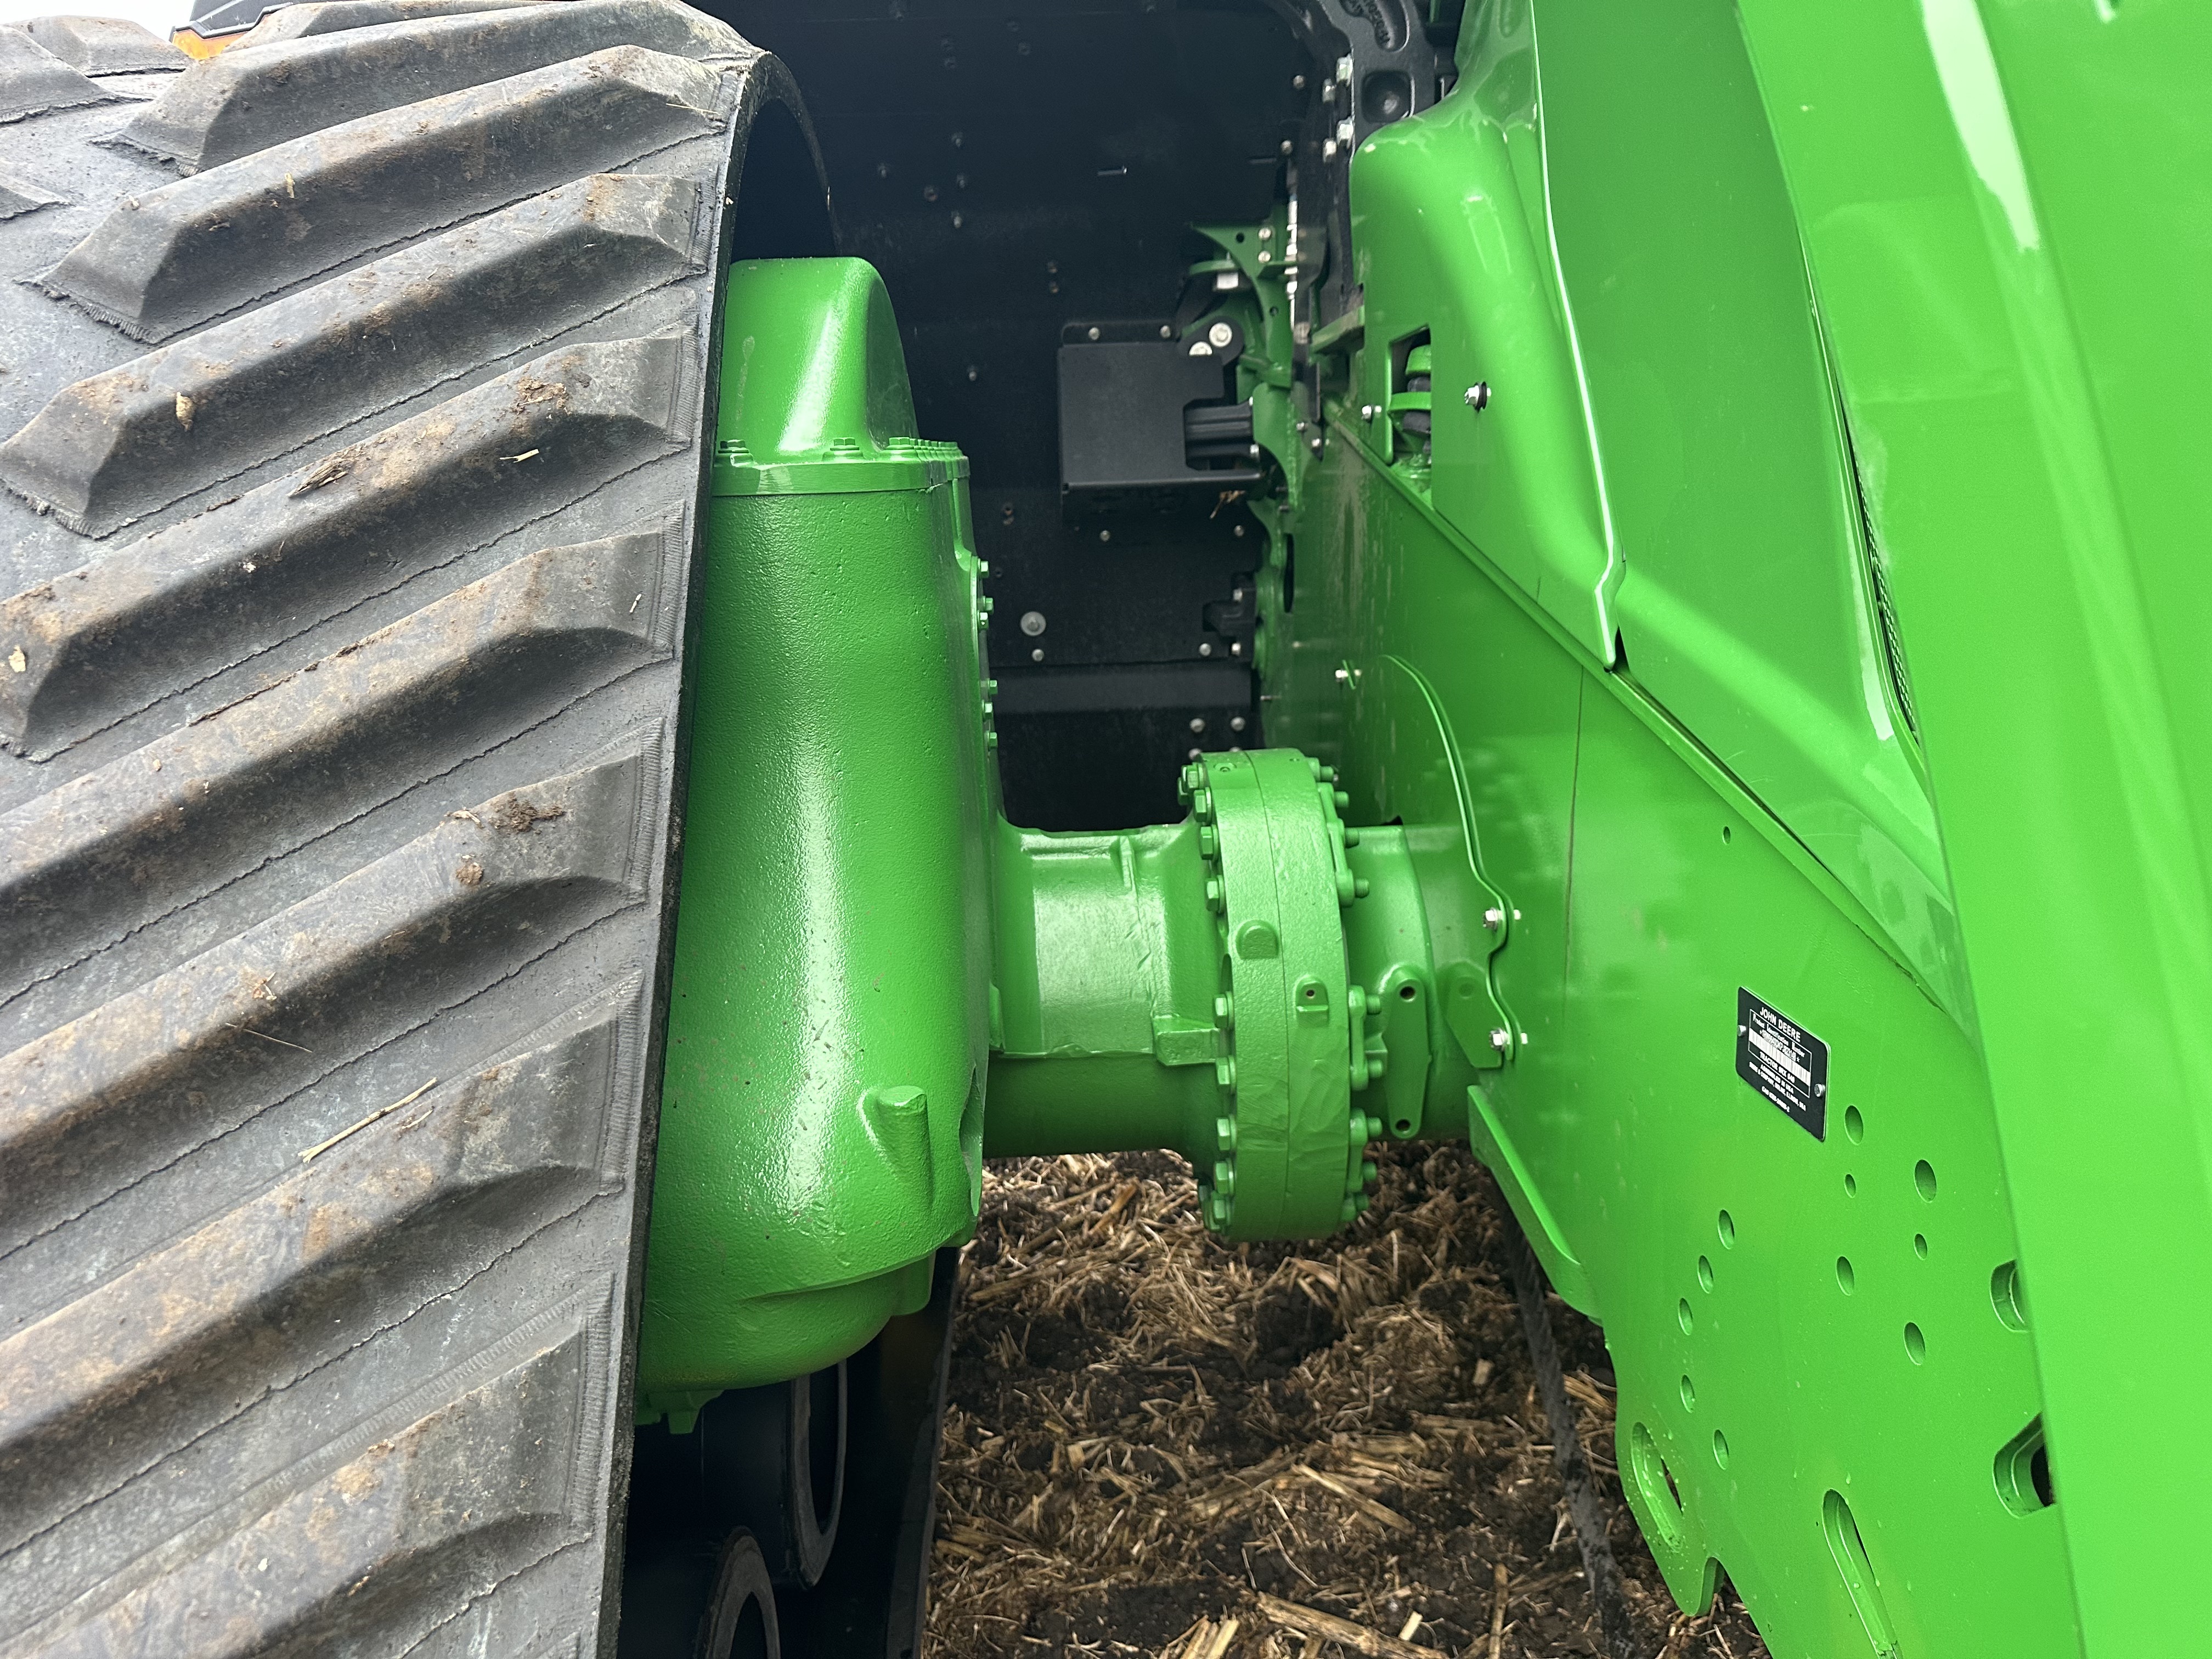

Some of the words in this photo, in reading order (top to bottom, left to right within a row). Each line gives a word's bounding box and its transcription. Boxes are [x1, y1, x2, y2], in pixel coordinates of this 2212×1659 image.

[1759, 1007, 1776, 1025] JOHN
[1778, 1019, 1800, 1042] DEERE
[1759, 1051, 1778, 1070] TRACTOR
